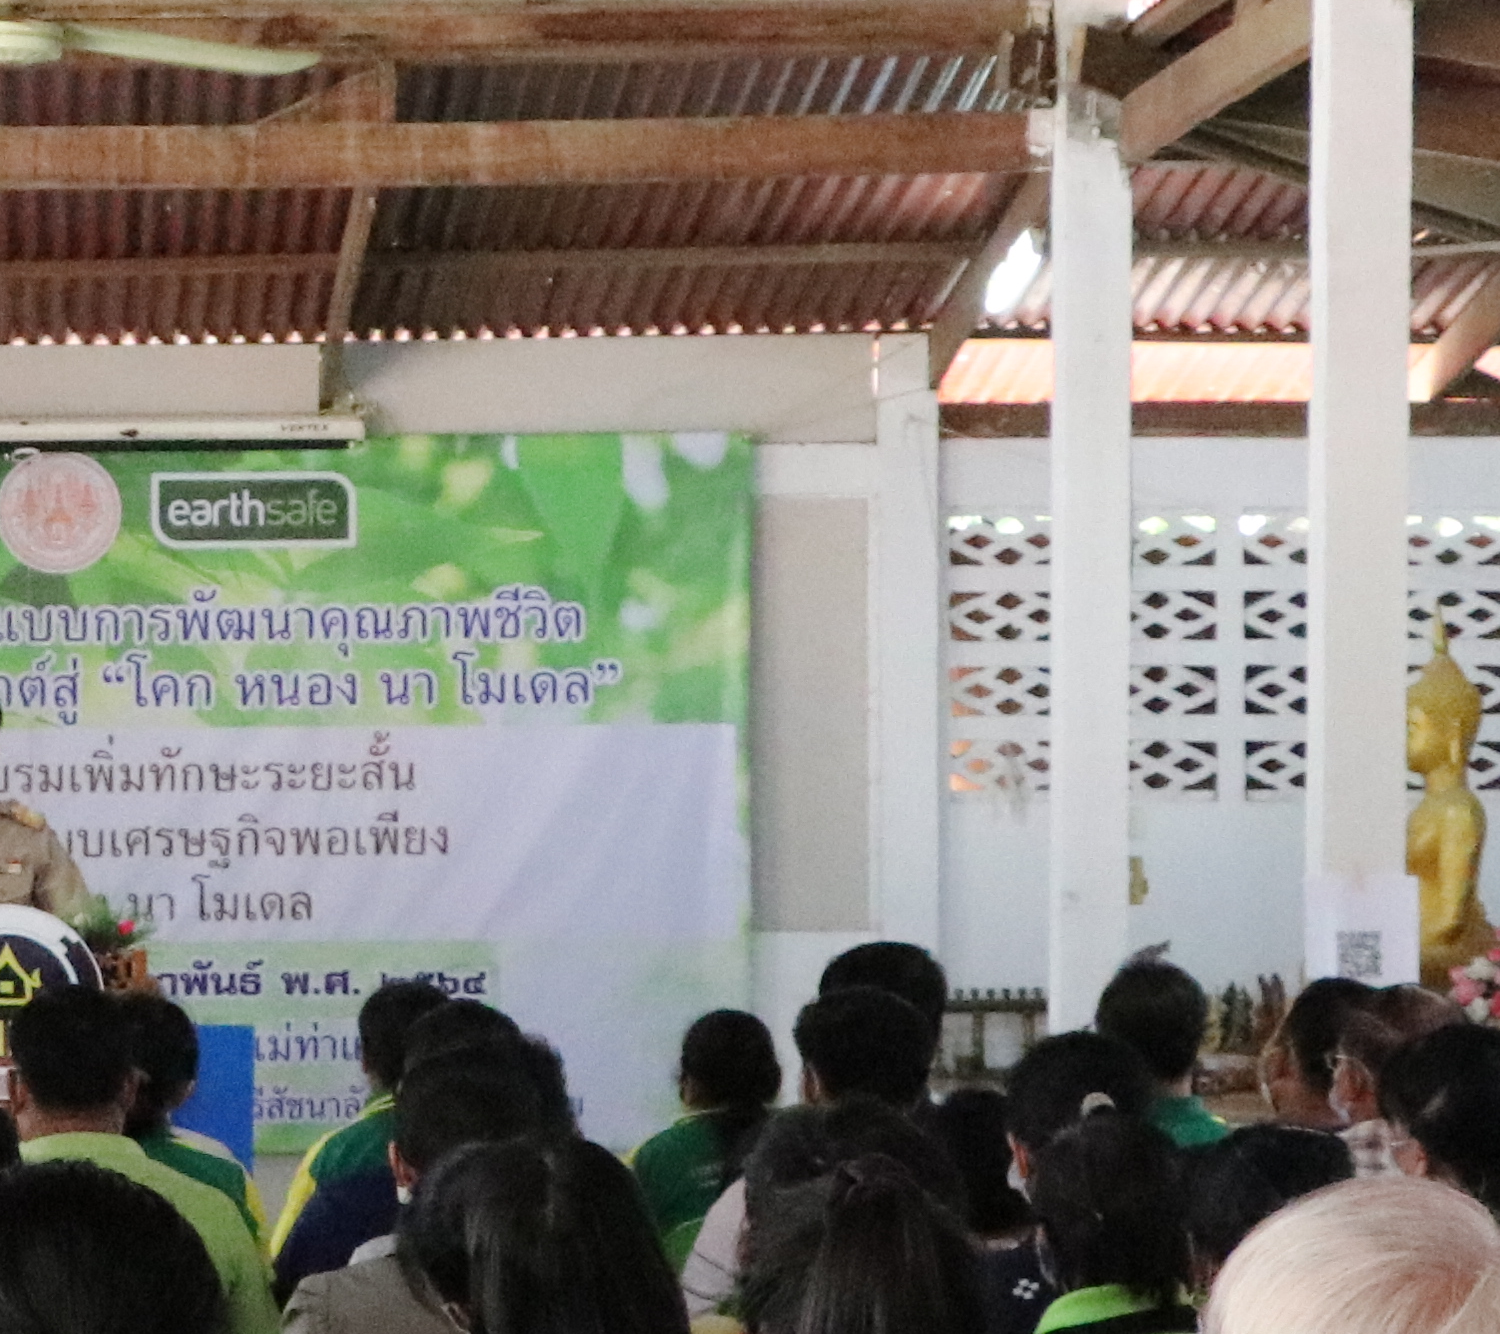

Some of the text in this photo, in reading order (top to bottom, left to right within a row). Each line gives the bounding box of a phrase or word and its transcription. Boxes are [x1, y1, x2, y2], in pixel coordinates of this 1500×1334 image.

[168, 489, 338, 527] earthsafe
[235, 667, 358, 706] หนอง
[380, 667, 436, 706] นา
[192, 874, 314, 921] โมเดล
[281, 969, 361, 998] พ.ศ.
